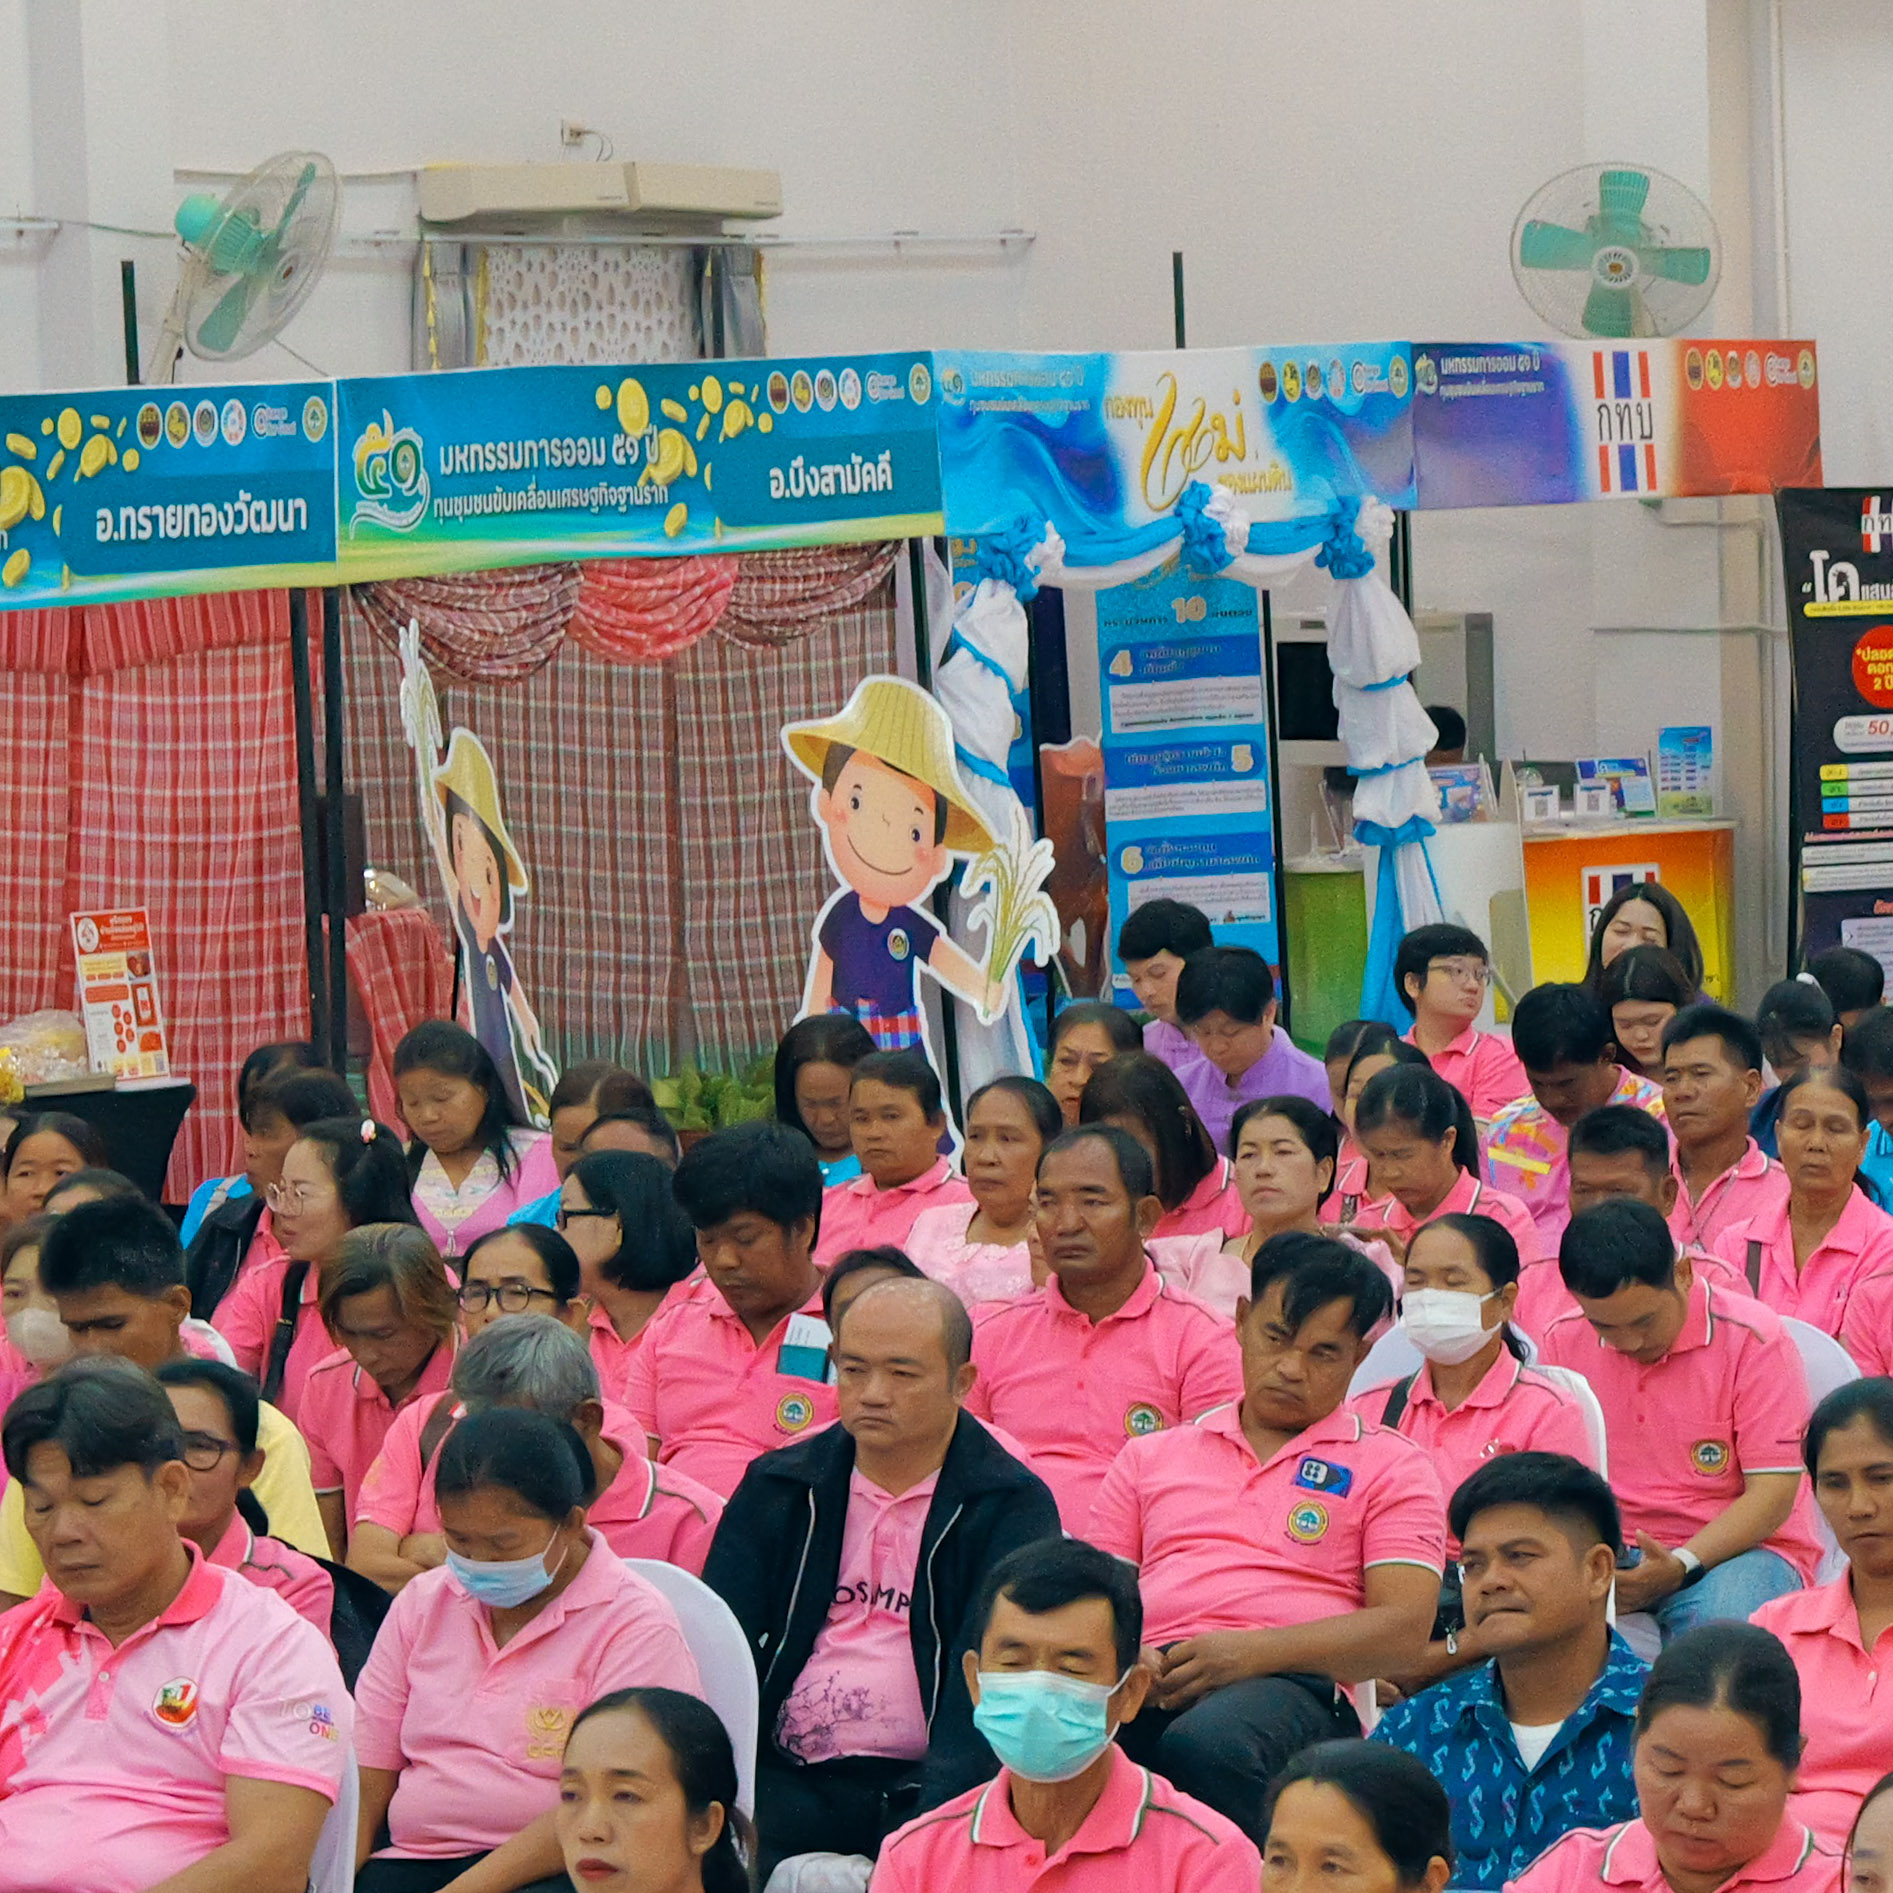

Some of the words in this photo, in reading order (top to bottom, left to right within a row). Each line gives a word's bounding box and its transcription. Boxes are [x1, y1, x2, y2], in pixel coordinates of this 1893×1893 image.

[1596, 401, 1654, 441] กทบ
[439, 436, 606, 476] มหกรรมการออม
[611, 433, 639, 466] ๕๑
[645, 424, 661, 464] ปี
[769, 450, 893, 499] อ.บึงสามัคคี
[96, 488, 308, 543] อ.ทรายทองวัฒนา
[433, 475, 669, 526] ทุนชุมชนขับเคลื่อนเศรษฐกิจฐานราก
[1171, 595, 1208, 624] 10
[1109, 649, 1134, 677] 4
[1873, 676, 1882, 691] 2
[1231, 743, 1255, 773] 5
[1121, 846, 1144, 875] 6
